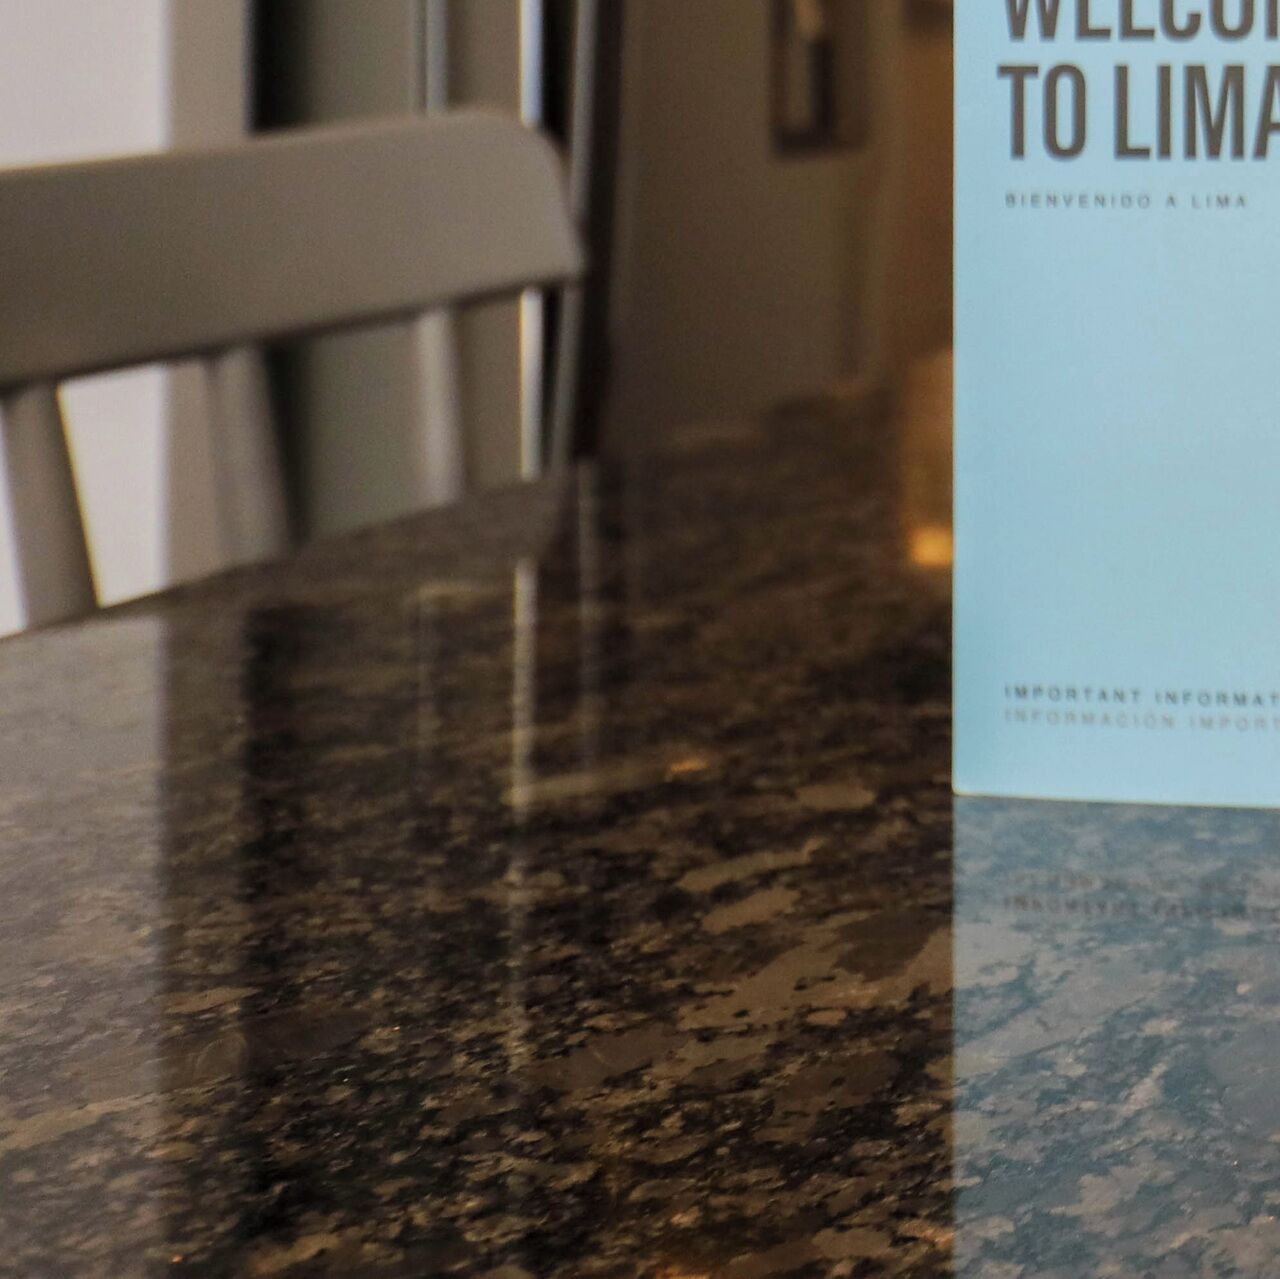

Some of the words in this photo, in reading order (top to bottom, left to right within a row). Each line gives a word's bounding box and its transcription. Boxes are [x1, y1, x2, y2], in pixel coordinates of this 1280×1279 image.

[997, 64, 1087, 160] TO
[1005, 193, 1151, 209] BIENVENIDO
[1166, 193, 1177, 209] A
[1191, 193, 1247, 209] LIMA
[1004, 685, 1141, 704] IMPORTANT
